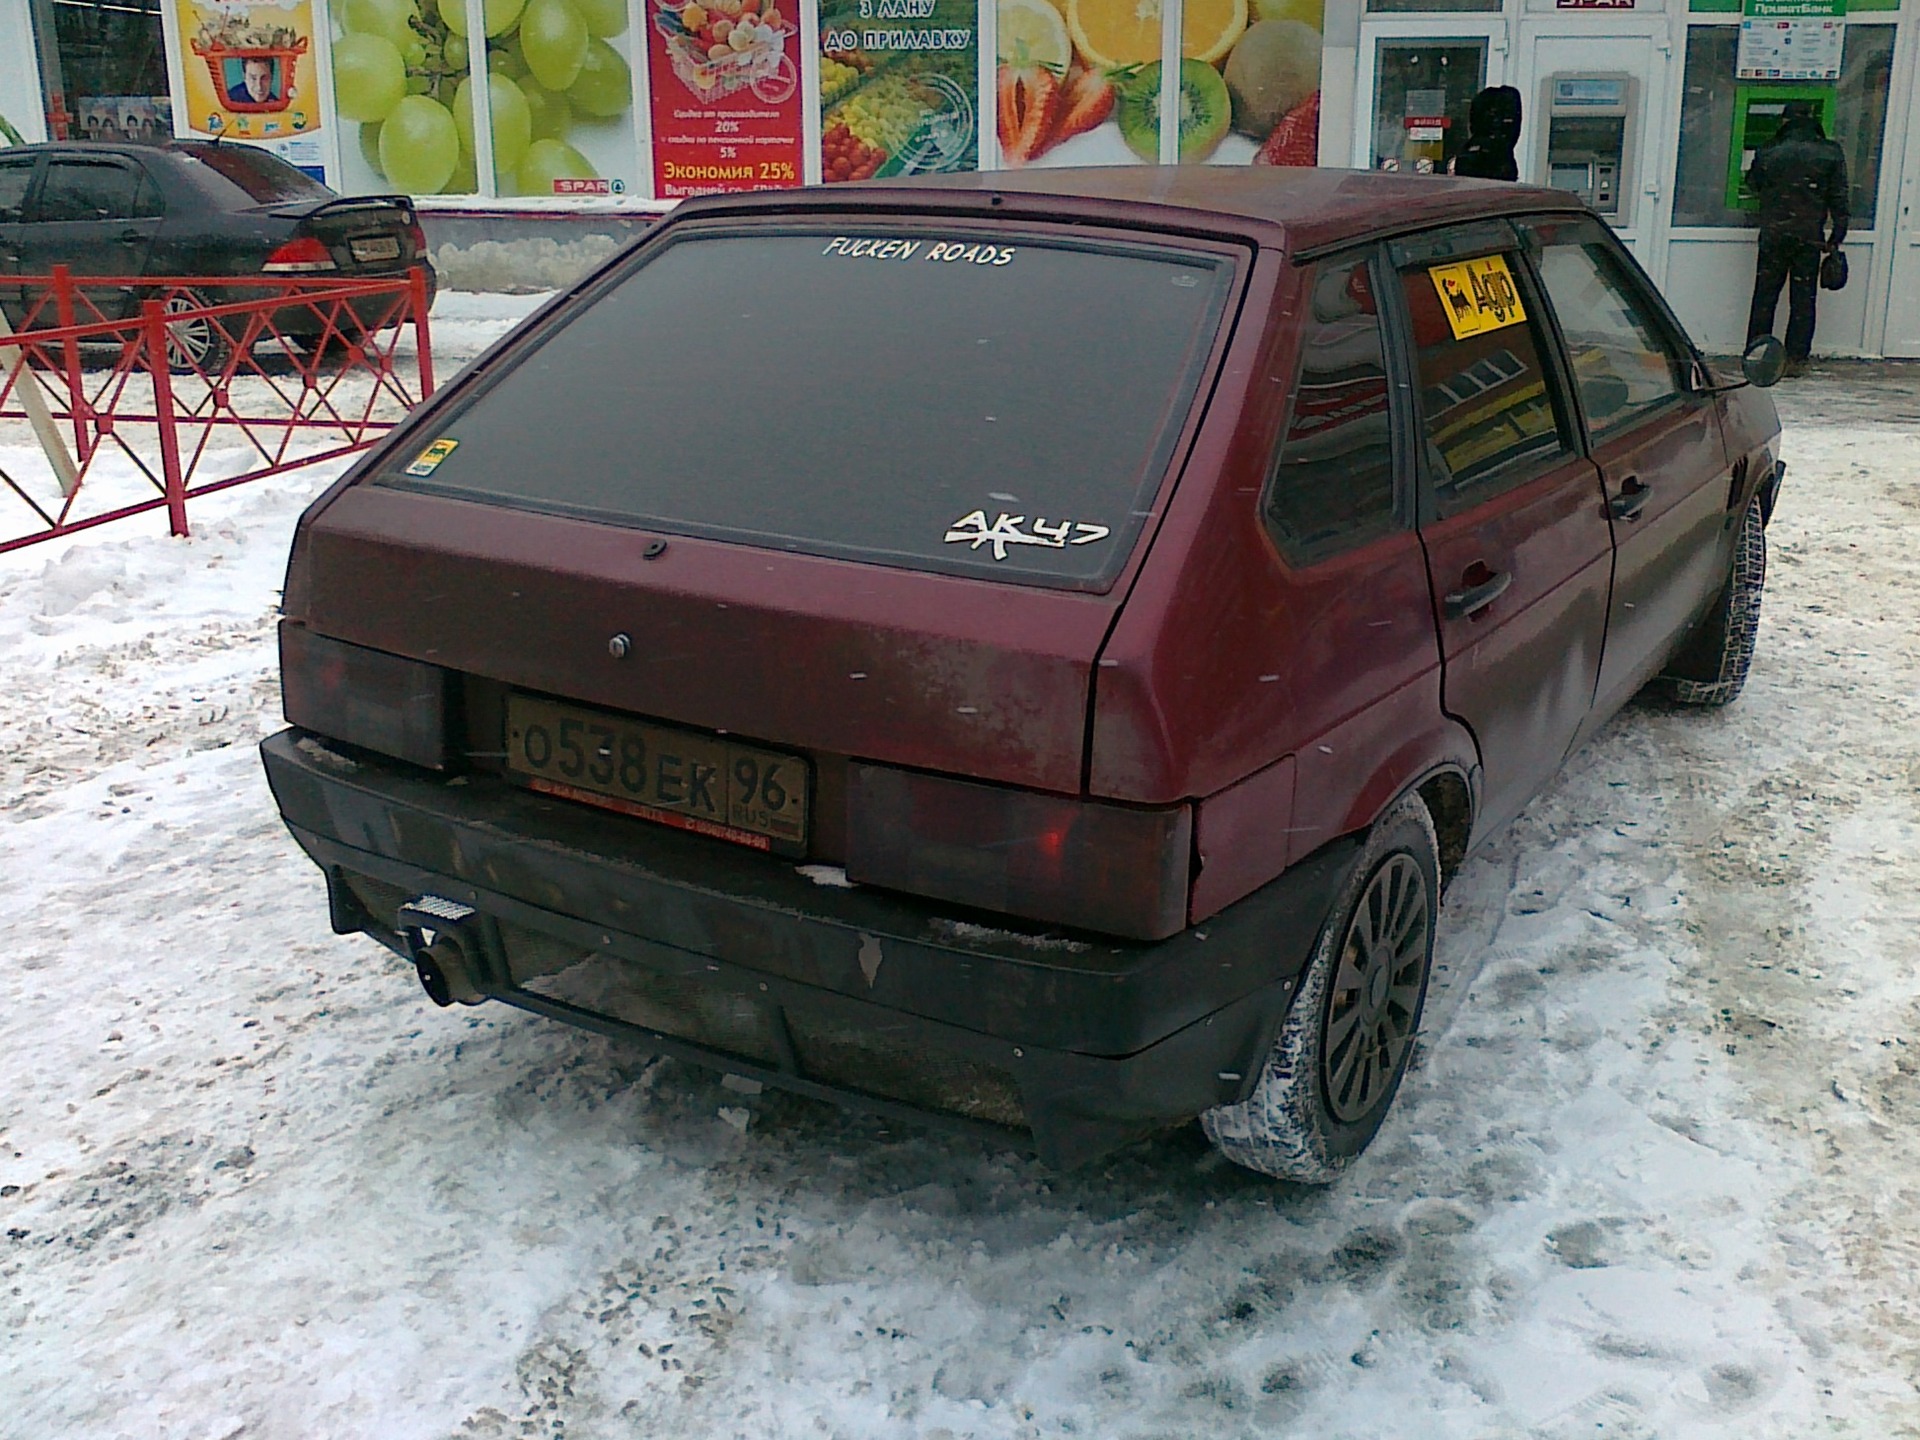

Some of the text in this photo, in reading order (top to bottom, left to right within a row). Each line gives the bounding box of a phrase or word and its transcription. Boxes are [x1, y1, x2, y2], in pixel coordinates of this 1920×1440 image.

[877, 0, 936, 18] ЛАНУ
[824, 30, 971, 51] ДО ПРИЛАВКУ
[715, 121, 739, 132] 20%
[720, 147, 737, 159] 5%
[664, 162, 795, 180] Экономия 25%
[560, 181, 608, 192] SPAR
[822, 237, 1016, 266] FUCKEN ROADS
[1466, 261, 1516, 323] Agip
[734, 756, 787, 812] 96
[732, 804, 771, 828] RUS
